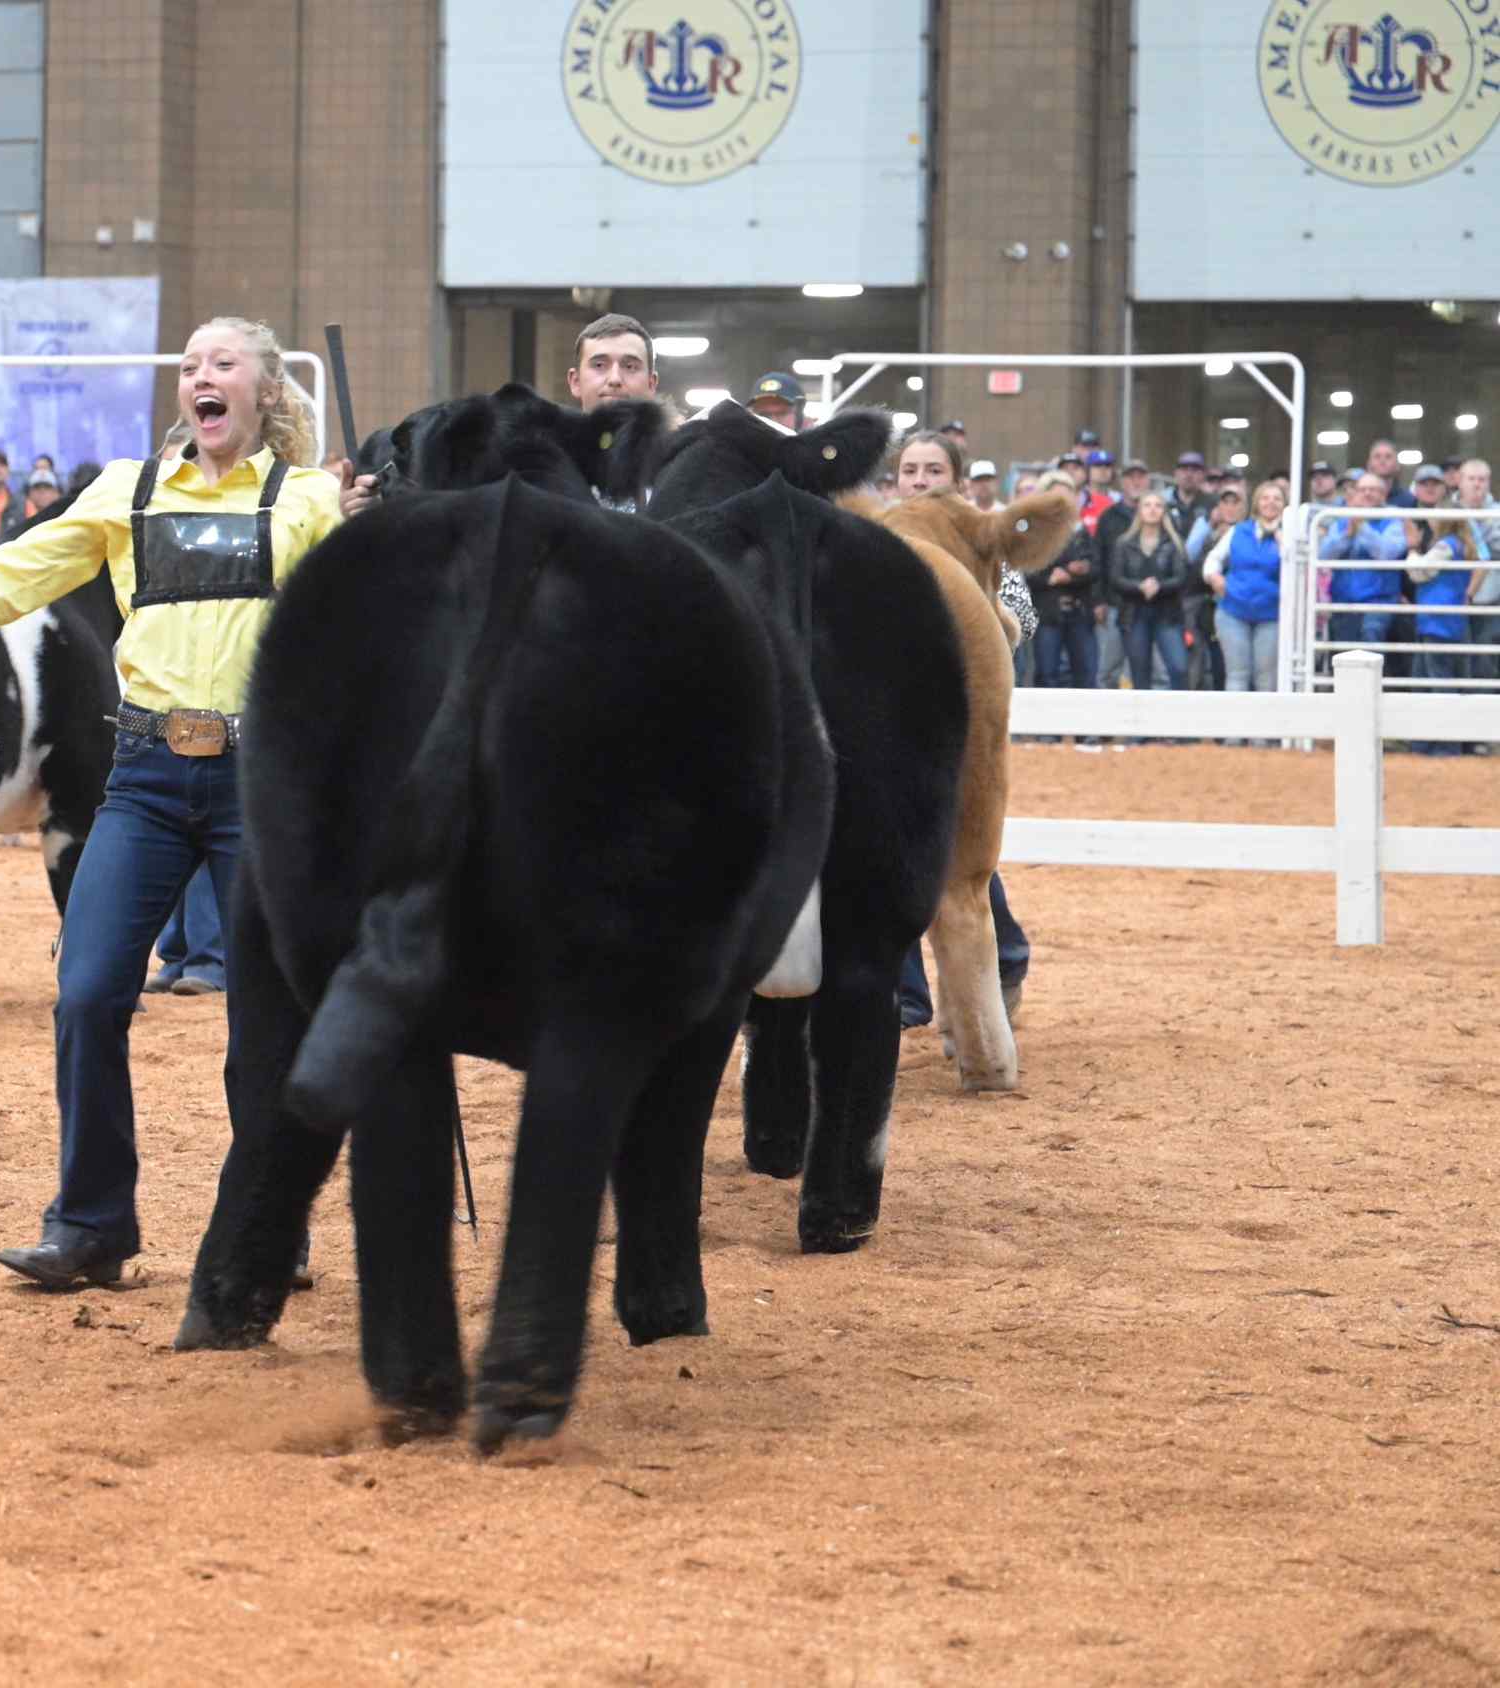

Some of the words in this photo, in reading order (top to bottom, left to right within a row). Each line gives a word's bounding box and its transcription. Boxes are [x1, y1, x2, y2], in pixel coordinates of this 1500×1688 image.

[609, 135, 689, 174] KANSAS
[702, 135, 748, 170] CITY
[1309, 132, 1393, 175] KANSAS
[1409, 132, 1459, 170] CITY
